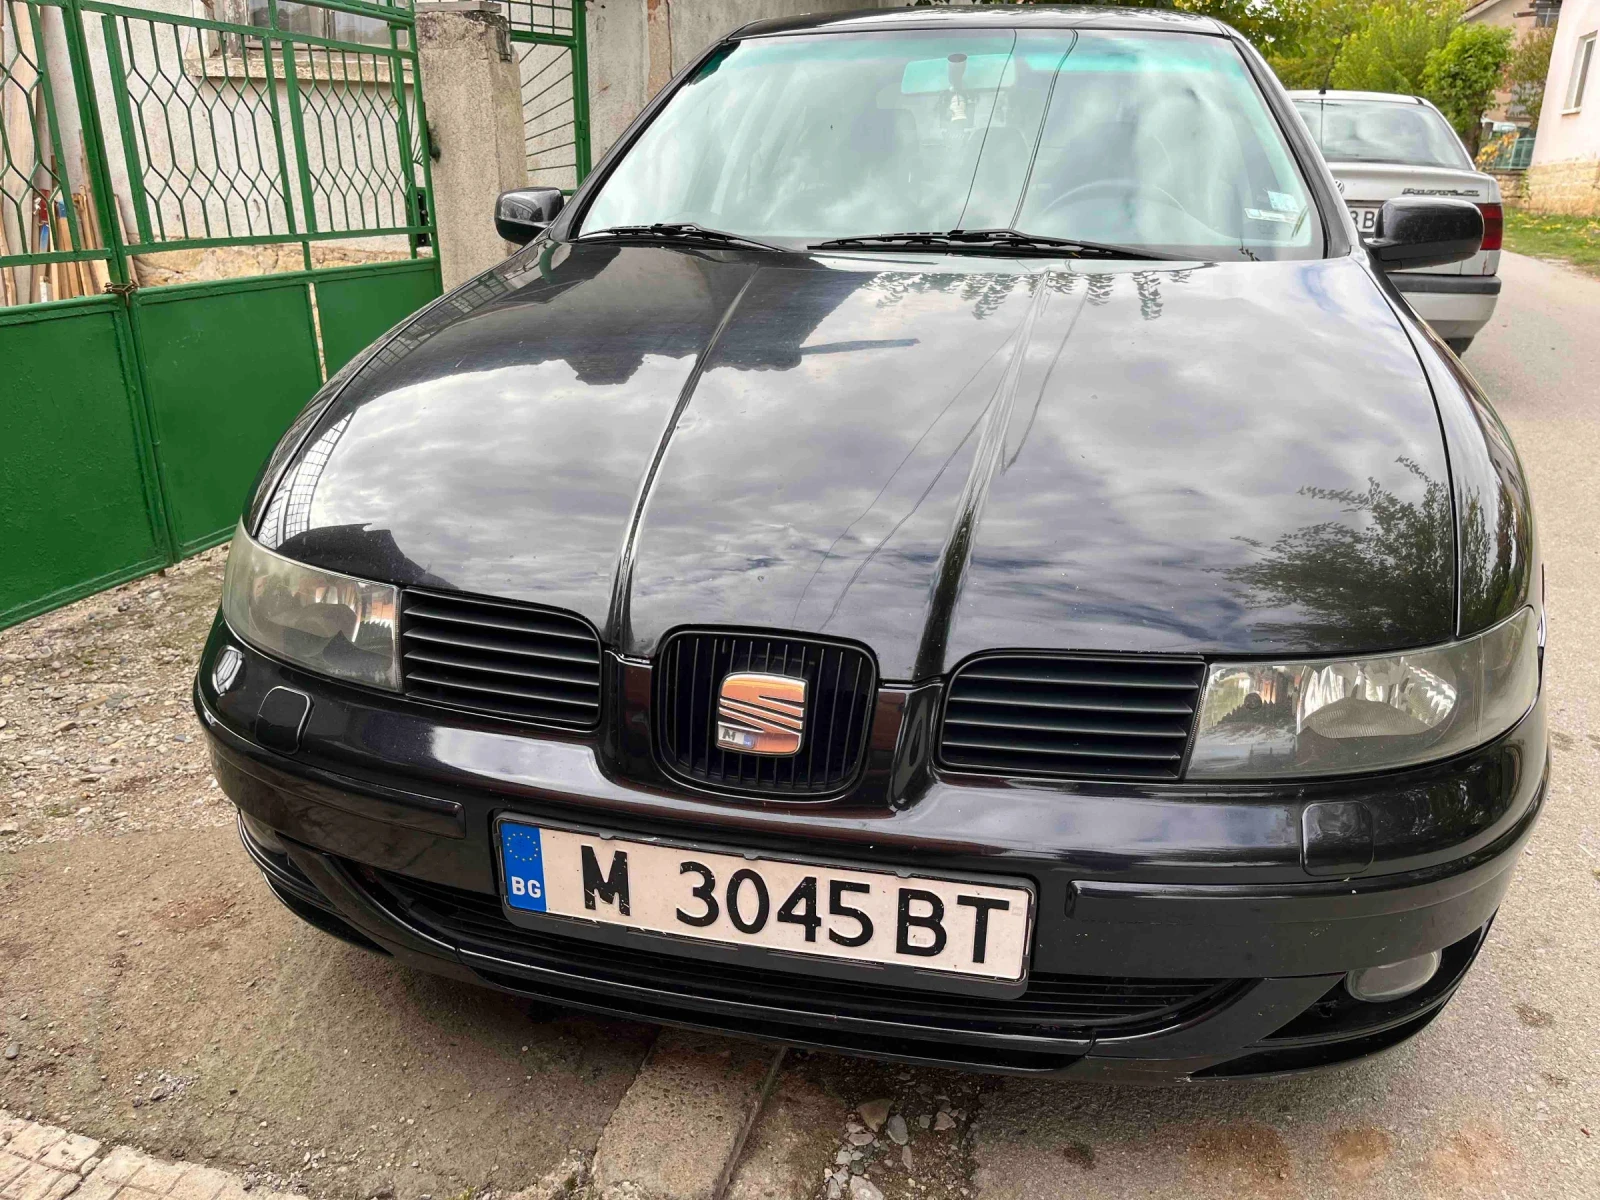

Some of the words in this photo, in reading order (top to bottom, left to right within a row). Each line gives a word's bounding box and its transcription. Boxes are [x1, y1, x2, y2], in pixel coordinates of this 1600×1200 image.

[511, 876, 541, 898] BG
[580, 845, 631, 917] M
[675, 860, 874, 948] 3045
[895, 887, 1010, 964] BT
